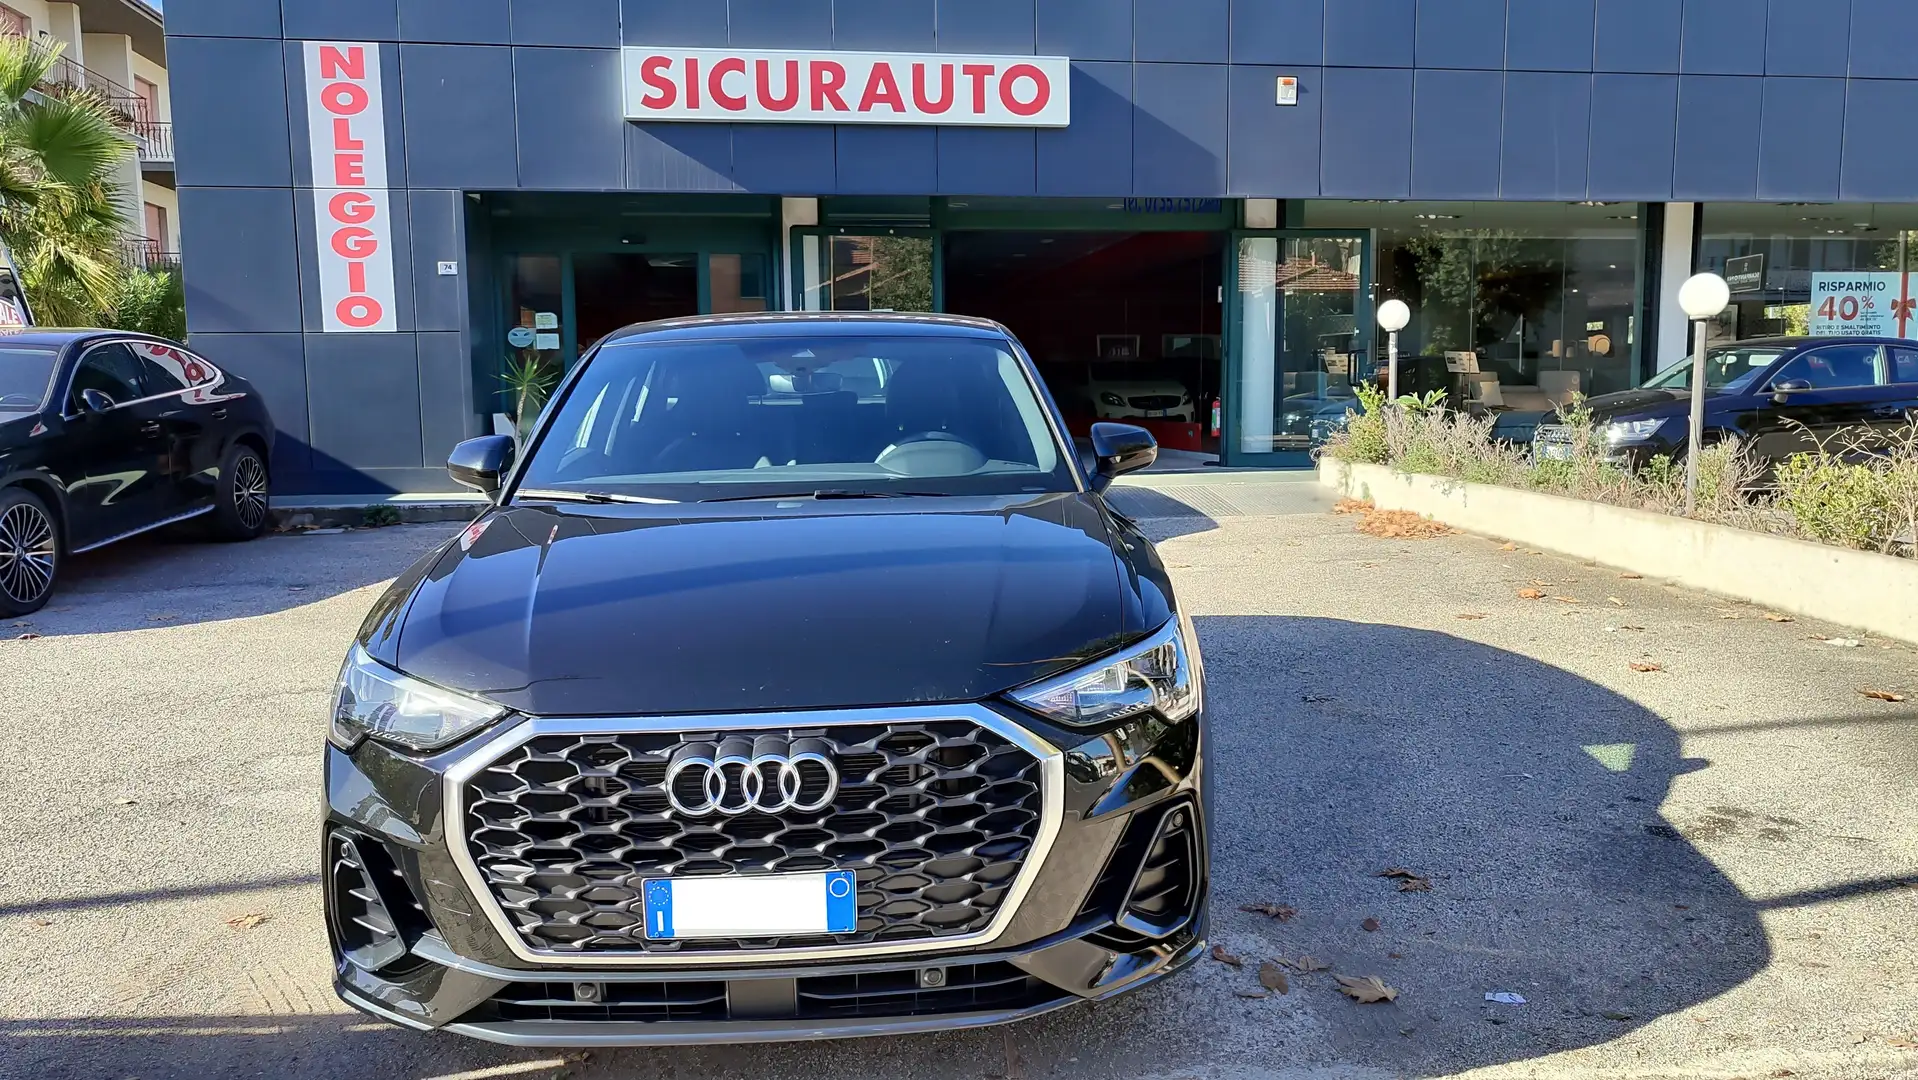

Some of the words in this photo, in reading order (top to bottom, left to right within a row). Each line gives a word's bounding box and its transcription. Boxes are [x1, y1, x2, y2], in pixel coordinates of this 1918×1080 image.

[640, 56, 1050, 116] SICURAUTO
[319, 46, 383, 328] NOLEGGIO
[443, 263, 453, 271] 74
[1818, 281, 1886, 292] RISPARMIO
